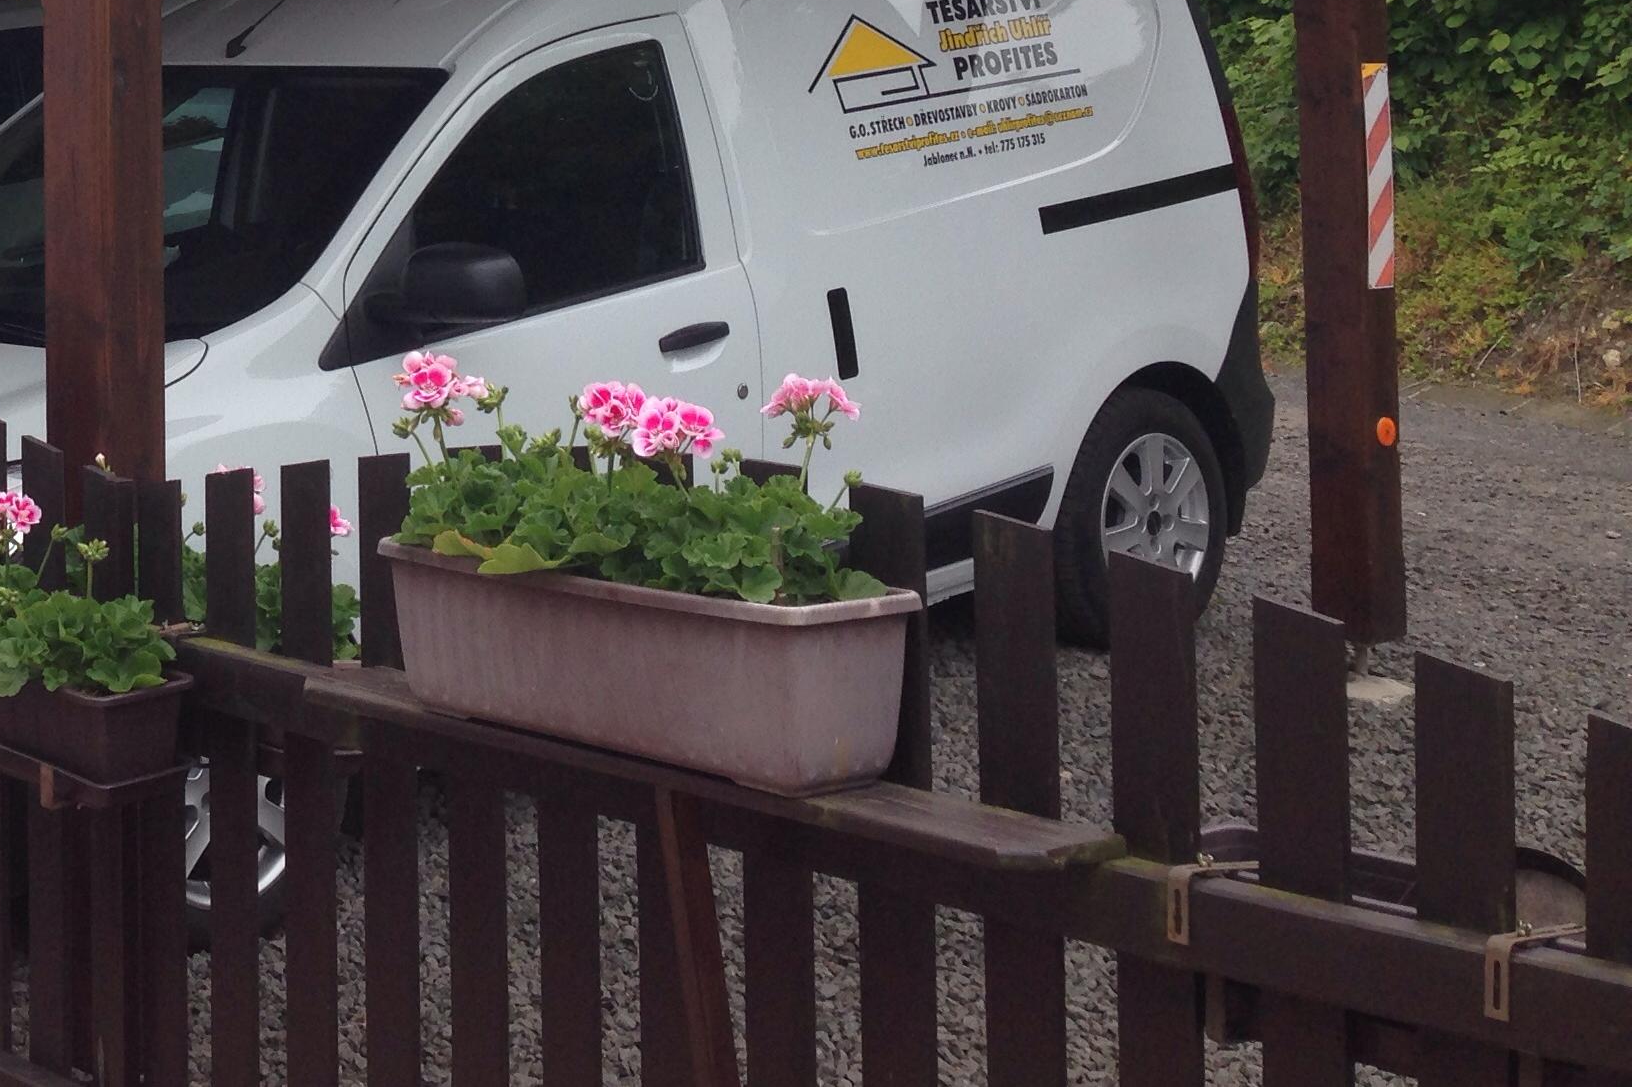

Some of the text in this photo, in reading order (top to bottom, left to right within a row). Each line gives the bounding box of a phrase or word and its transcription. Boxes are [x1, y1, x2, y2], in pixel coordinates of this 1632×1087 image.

[938, 13, 1051, 52] Jindřich Uhlíř
[953, 41, 1058, 81] PROFITES
[913, 103, 978, 127] DŘEVOSTAVBY
[986, 96, 1016, 113] KROVY
[1000, 138, 1016, 152] 775
[1017, 135, 1031, 149] 175
[1032, 132, 1046, 146] 315
